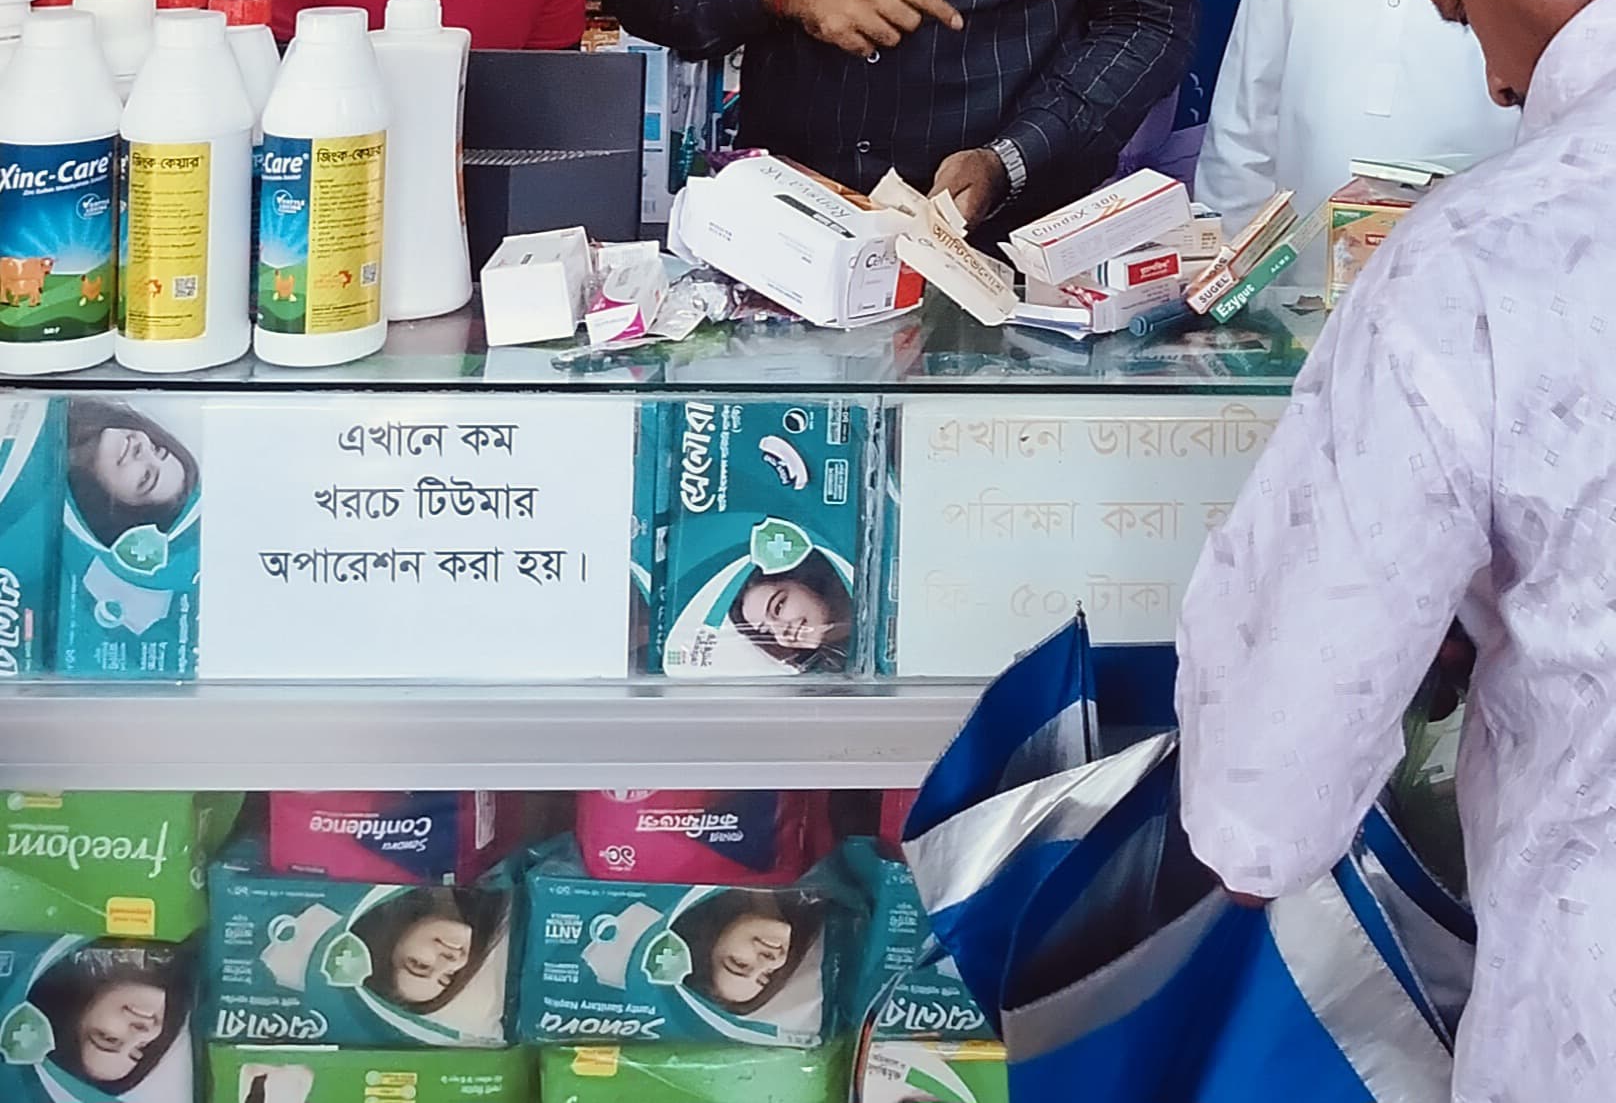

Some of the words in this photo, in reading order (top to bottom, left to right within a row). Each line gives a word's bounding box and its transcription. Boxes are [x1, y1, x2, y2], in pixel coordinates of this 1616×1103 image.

[1091, 193, 1120, 211] 300
[1198, 274, 1229, 304] SUGEL
[1215, 282, 1256, 320] Ezygut
[338, 423, 446, 458] এখানে
[458, 424, 518, 456] কম
[928, 418, 1070, 460] এখানে
[314, 485, 403, 520] খরচে
[415, 475, 538, 520] টিউমার
[1098, 500, 1185, 541] করা
[259, 548, 425, 584] অপারেশন
[436, 547, 503, 583] করা
[516, 549, 567, 583] হয়
[308, 812, 433, 839] Confidence
[7, 821, 169, 878] freedom
[545, 925, 583, 938] ANTI
[216, 1008, 329, 1041] সেনোরা
